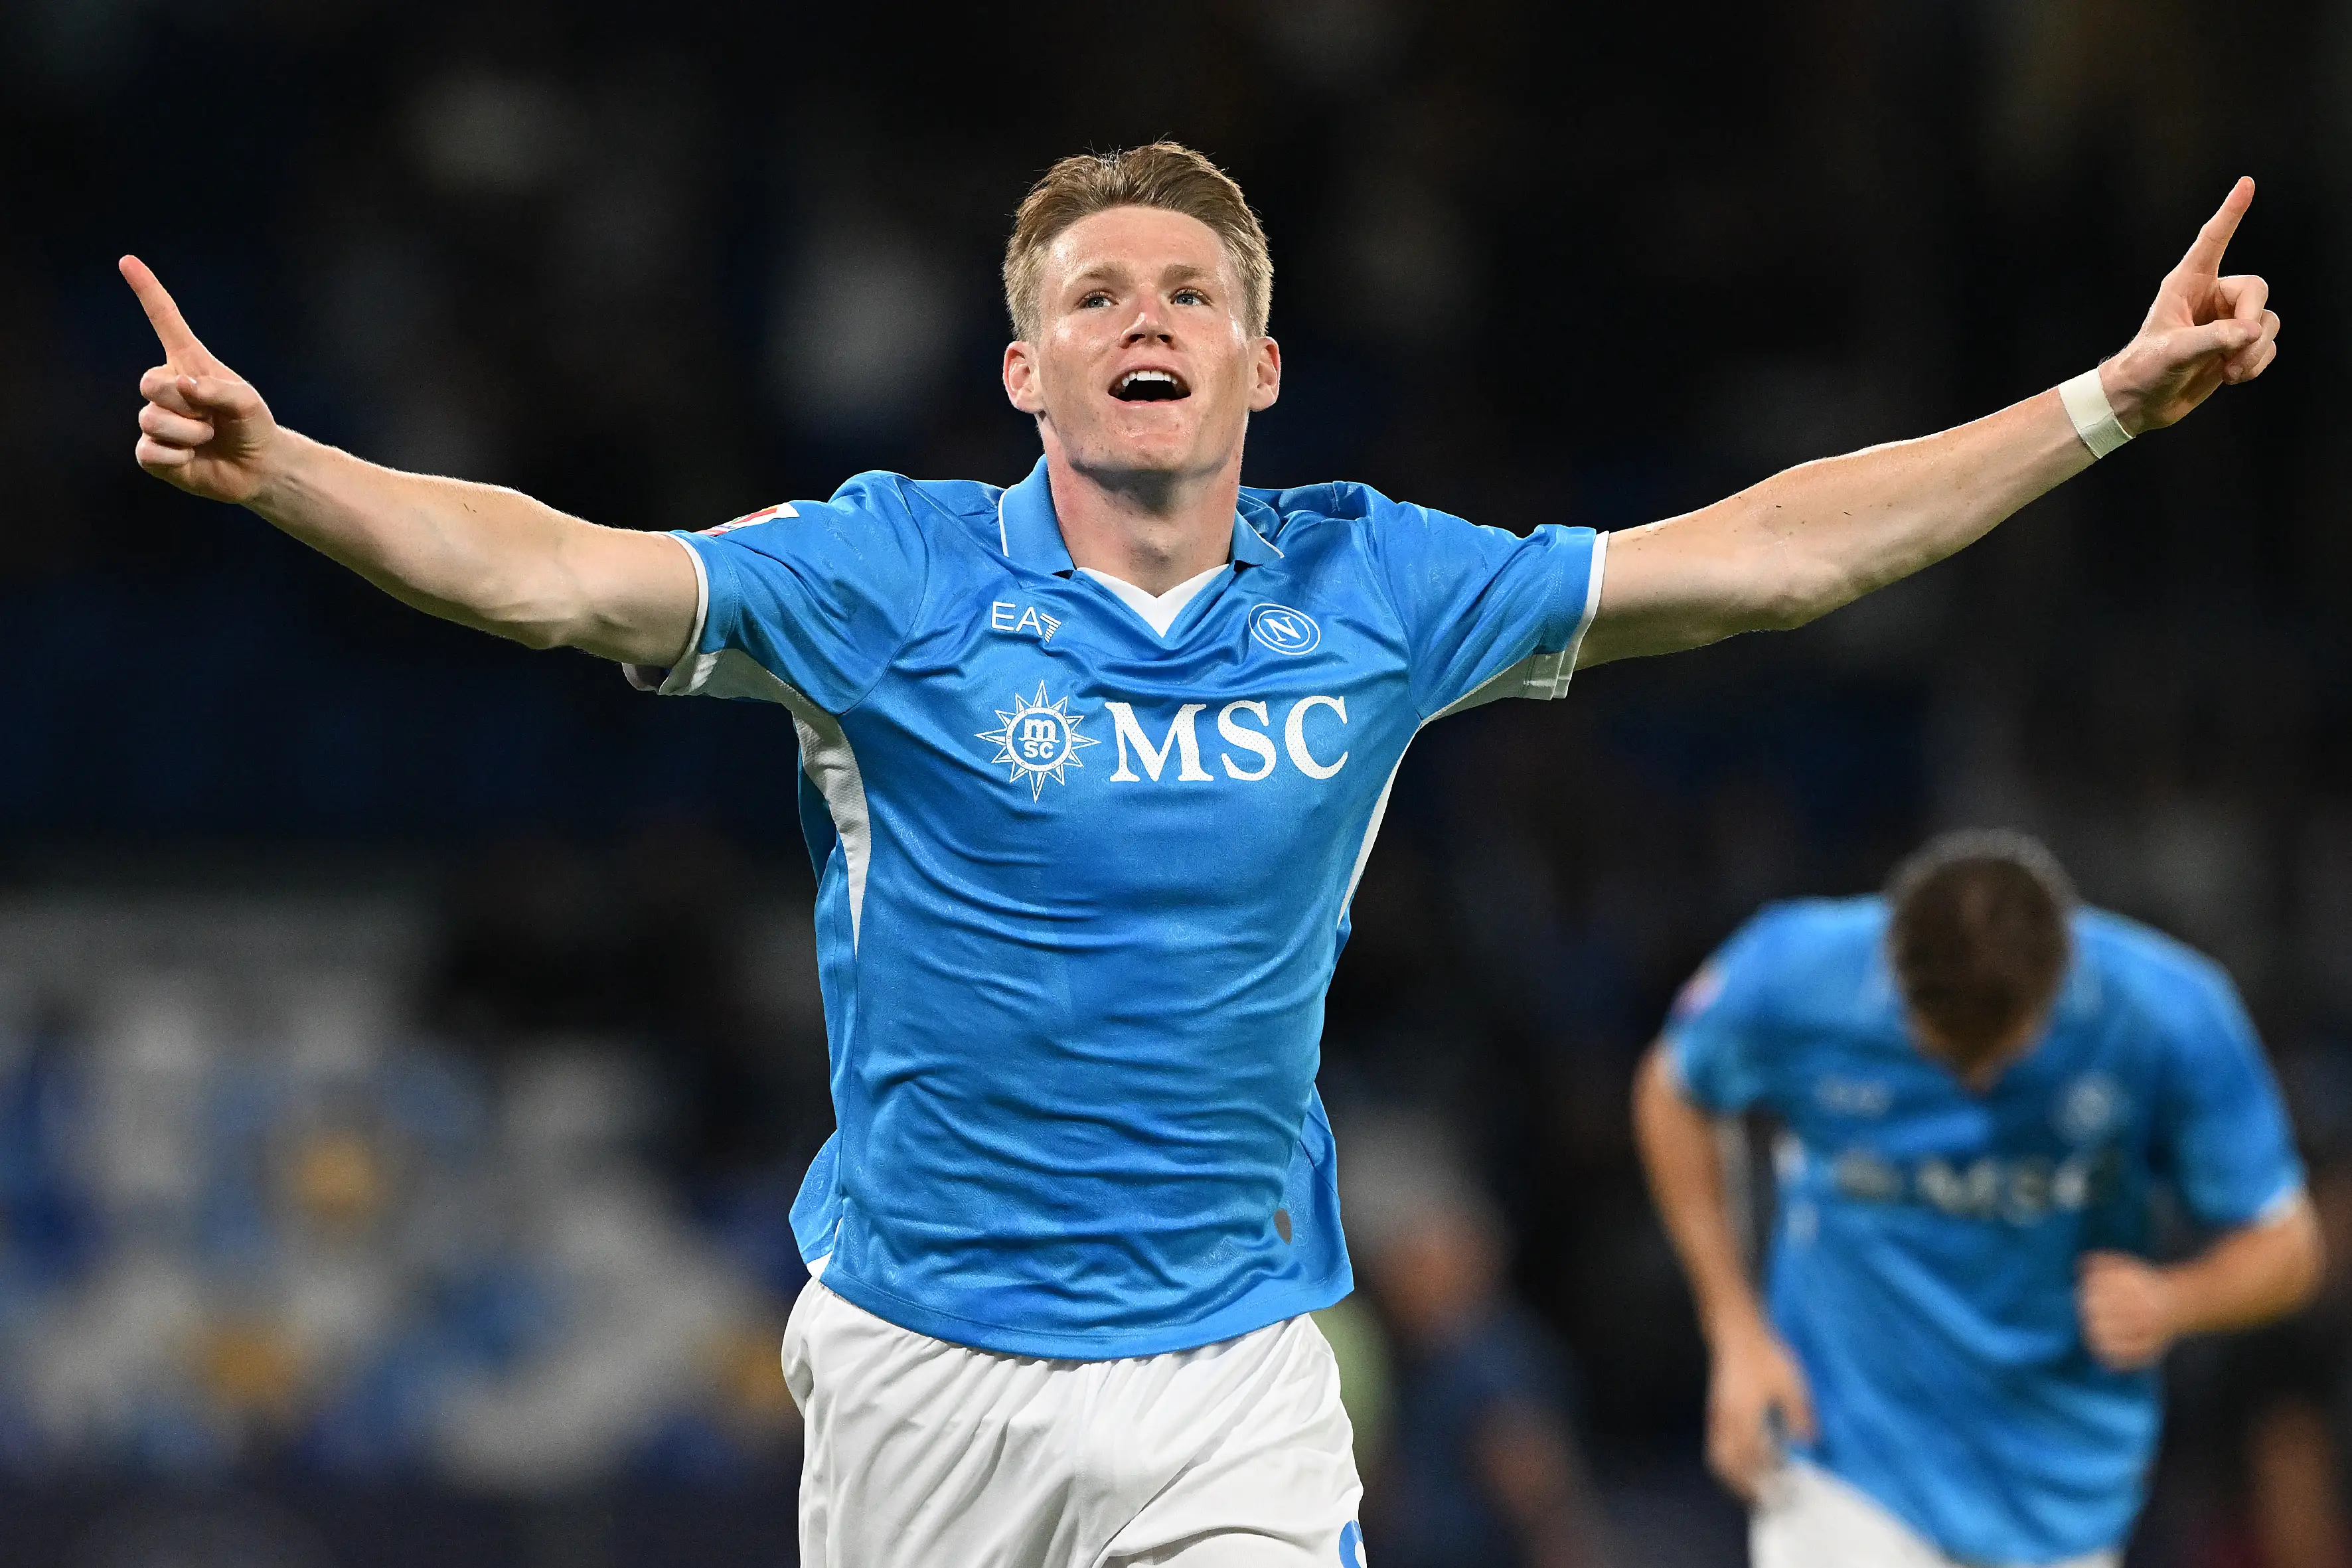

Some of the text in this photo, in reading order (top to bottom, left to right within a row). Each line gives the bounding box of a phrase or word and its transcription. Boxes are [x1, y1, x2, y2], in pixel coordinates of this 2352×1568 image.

[991, 601, 1062, 643] EA7
[1263, 616, 1301, 642] N
[1104, 695, 1348, 782] MSC
